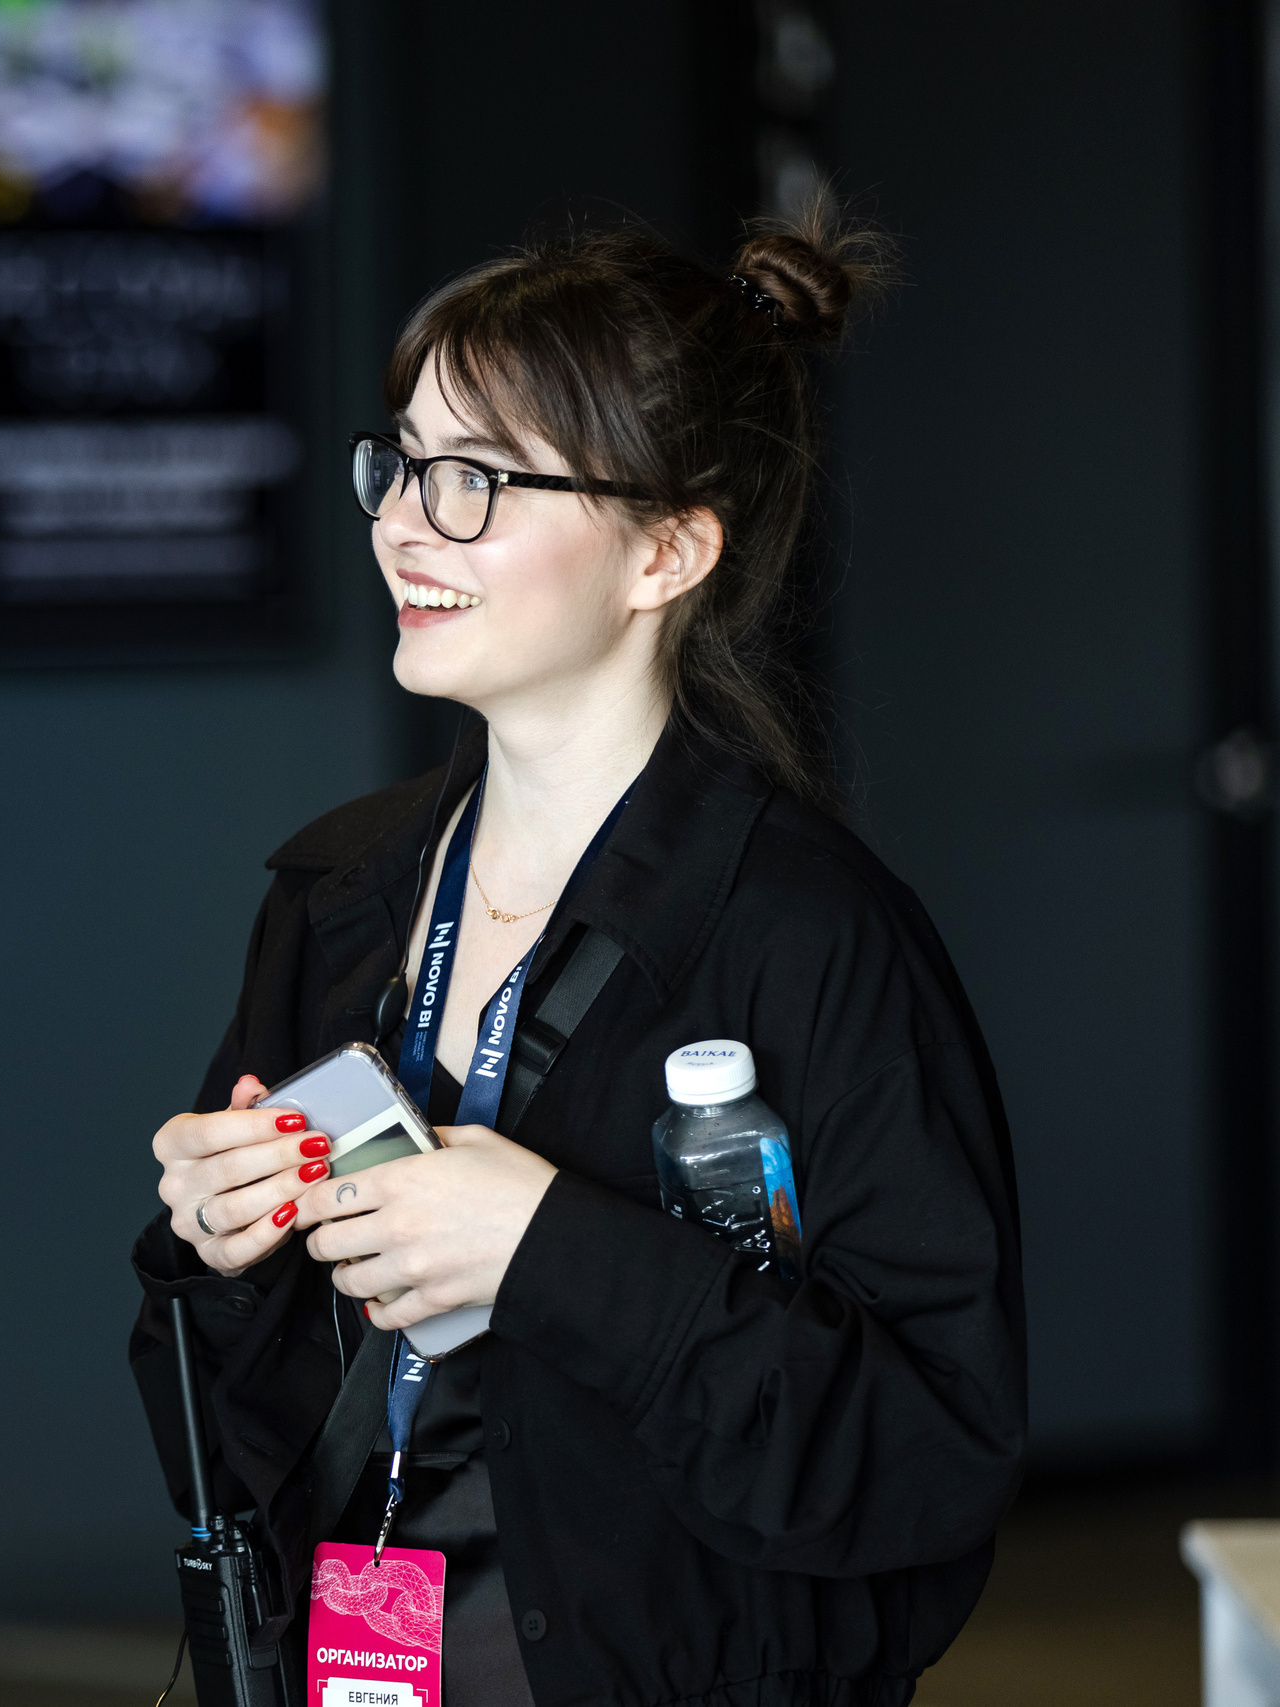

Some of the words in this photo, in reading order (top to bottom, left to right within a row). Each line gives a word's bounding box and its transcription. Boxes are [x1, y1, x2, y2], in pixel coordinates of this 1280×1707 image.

[423, 952, 444, 1007] NOVO
[417, 1009, 433, 1028] BI
[488, 987, 512, 1045] NOVO
[316, 1647, 428, 1672] ОРГАНИЗАТОР
[348, 1691, 399, 1706] ЕВГЕНИЯ
